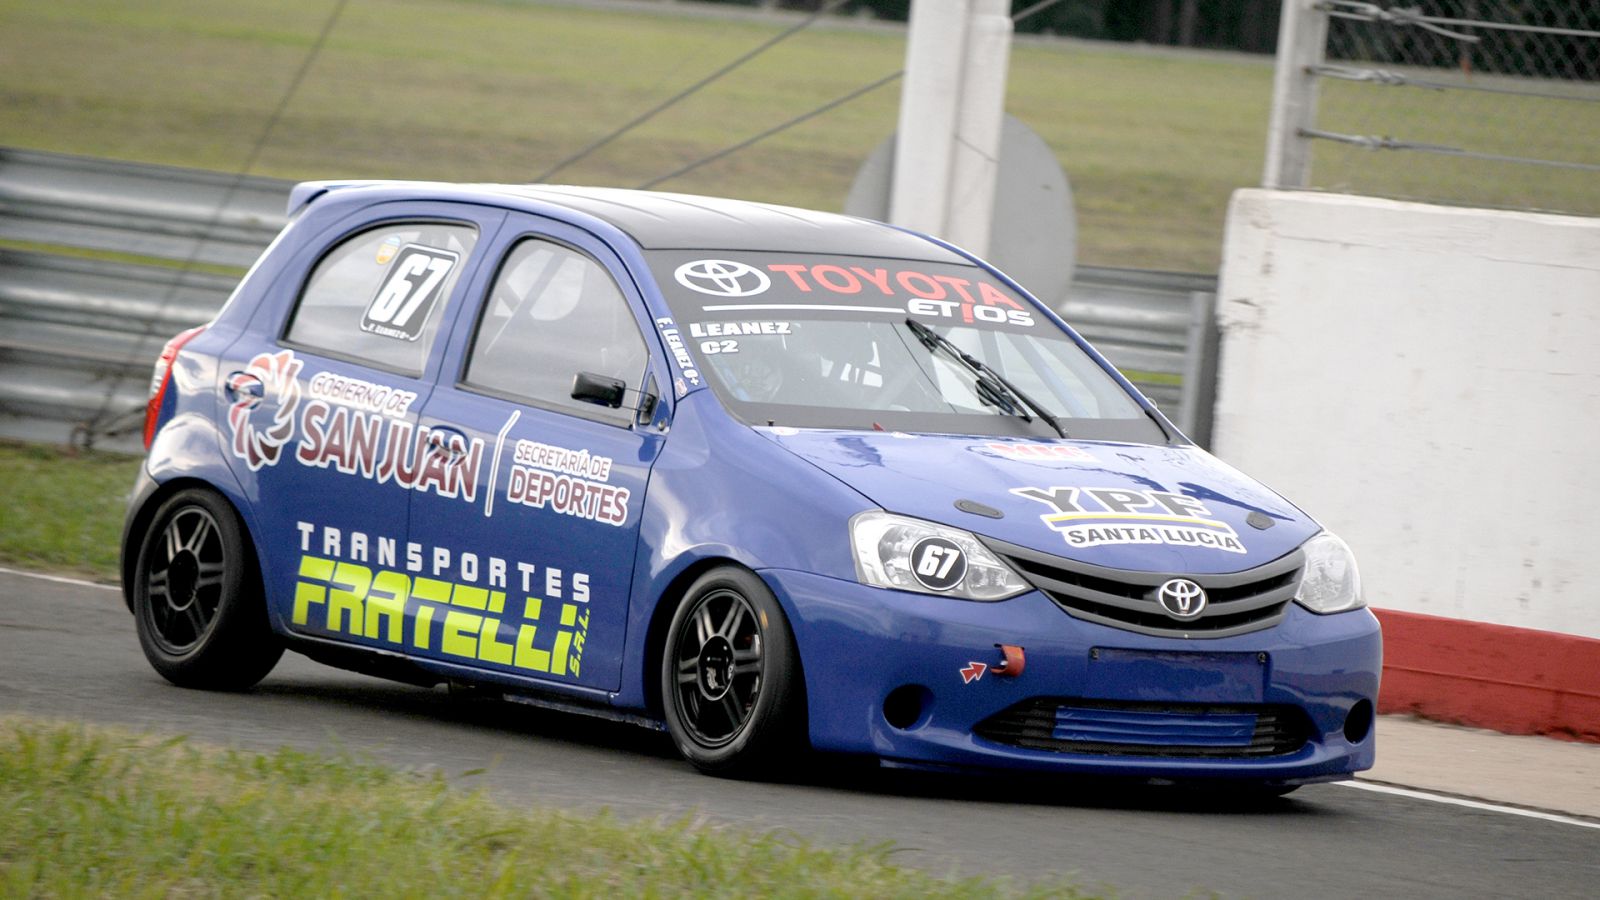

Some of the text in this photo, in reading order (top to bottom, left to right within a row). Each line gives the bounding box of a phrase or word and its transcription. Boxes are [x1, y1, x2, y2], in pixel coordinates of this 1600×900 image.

[368, 253, 454, 327] 67
[767, 263, 1025, 310] TOYOTA
[690, 321, 793, 338] LEANEZ
[701, 340, 739, 355] C2
[311, 375, 413, 414] GOBIERNO DE
[298, 404, 482, 500] SAN JUAN
[515, 442, 610, 479] SECRETARÍA DE
[509, 468, 629, 524] DEPORTES
[1015, 487, 1209, 517] YPF
[1067, 527, 1242, 551] SANTA LUCIA
[297, 521, 591, 603] TRANSPORTES
[917, 544, 960, 580] 67
[291, 555, 578, 676] FRATELLI
